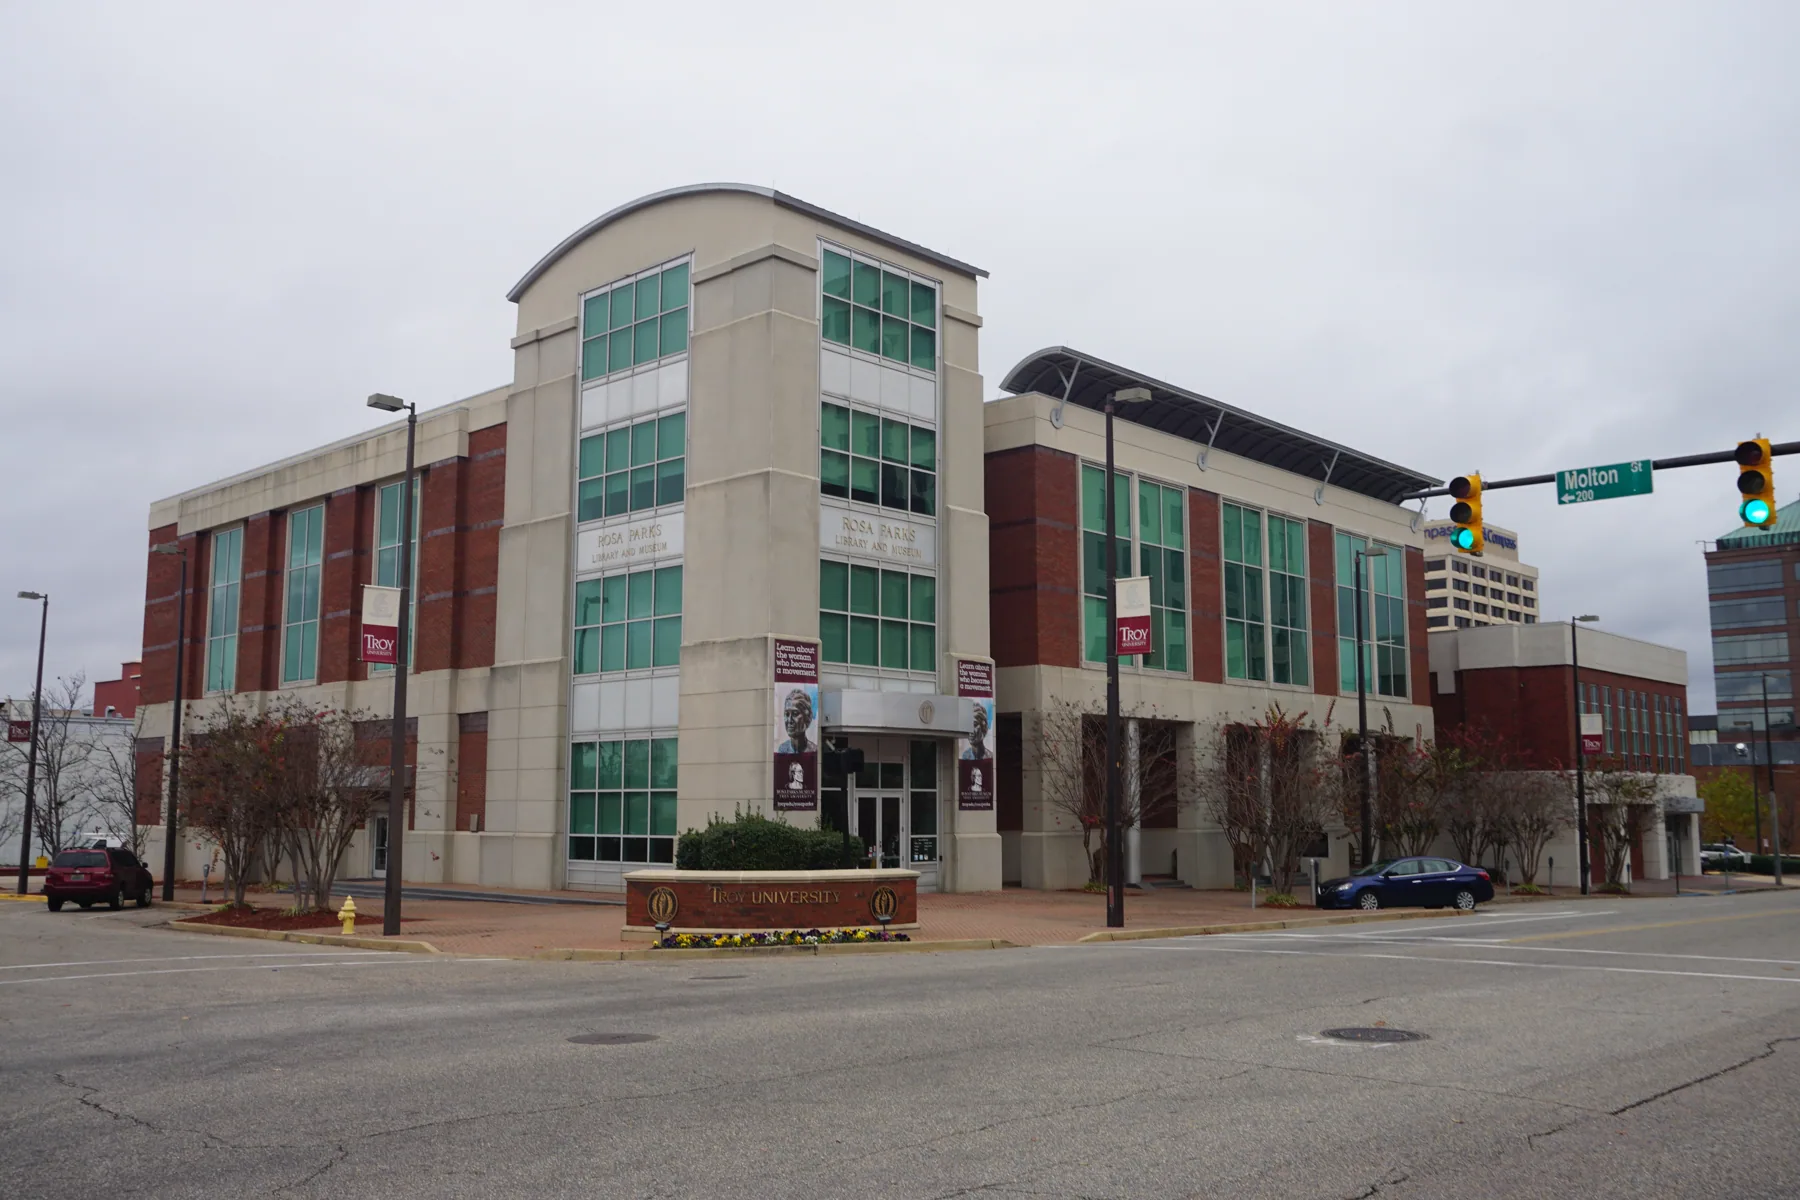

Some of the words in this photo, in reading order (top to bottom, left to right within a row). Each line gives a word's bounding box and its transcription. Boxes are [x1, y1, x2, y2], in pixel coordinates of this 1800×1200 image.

[1564, 468, 1619, 490] Molton
[1630, 461, 1643, 473] St
[1576, 489, 1594, 502] 200
[598, 532, 624, 548] ROSA
[628, 524, 663, 542] PARKS
[842, 516, 874, 535] ROSA
[880, 524, 916, 542] PARKS
[835, 534, 868, 549] LIBRARY
[871, 541, 888, 552] AND
[891, 544, 922, 558] MUSEUM
[1487, 529, 1517, 549] Compass
[591, 550, 620, 563] LIBRARY
[621, 547, 636, 558] AND
[638, 542, 667, 555] MUSEUM
[363, 634, 395, 651] TROY
[1119, 626, 1149, 641] TROY
[776, 643, 795, 652] Learn
[796, 645, 815, 654] about
[776, 651, 788, 659] the
[776, 659, 790, 667] who
[790, 660, 816, 669] became
[959, 662, 975, 670] Learn
[975, 663, 990, 671] about
[709, 885, 745, 903] TROY
[751, 891, 841, 904] UNIVERSITY
